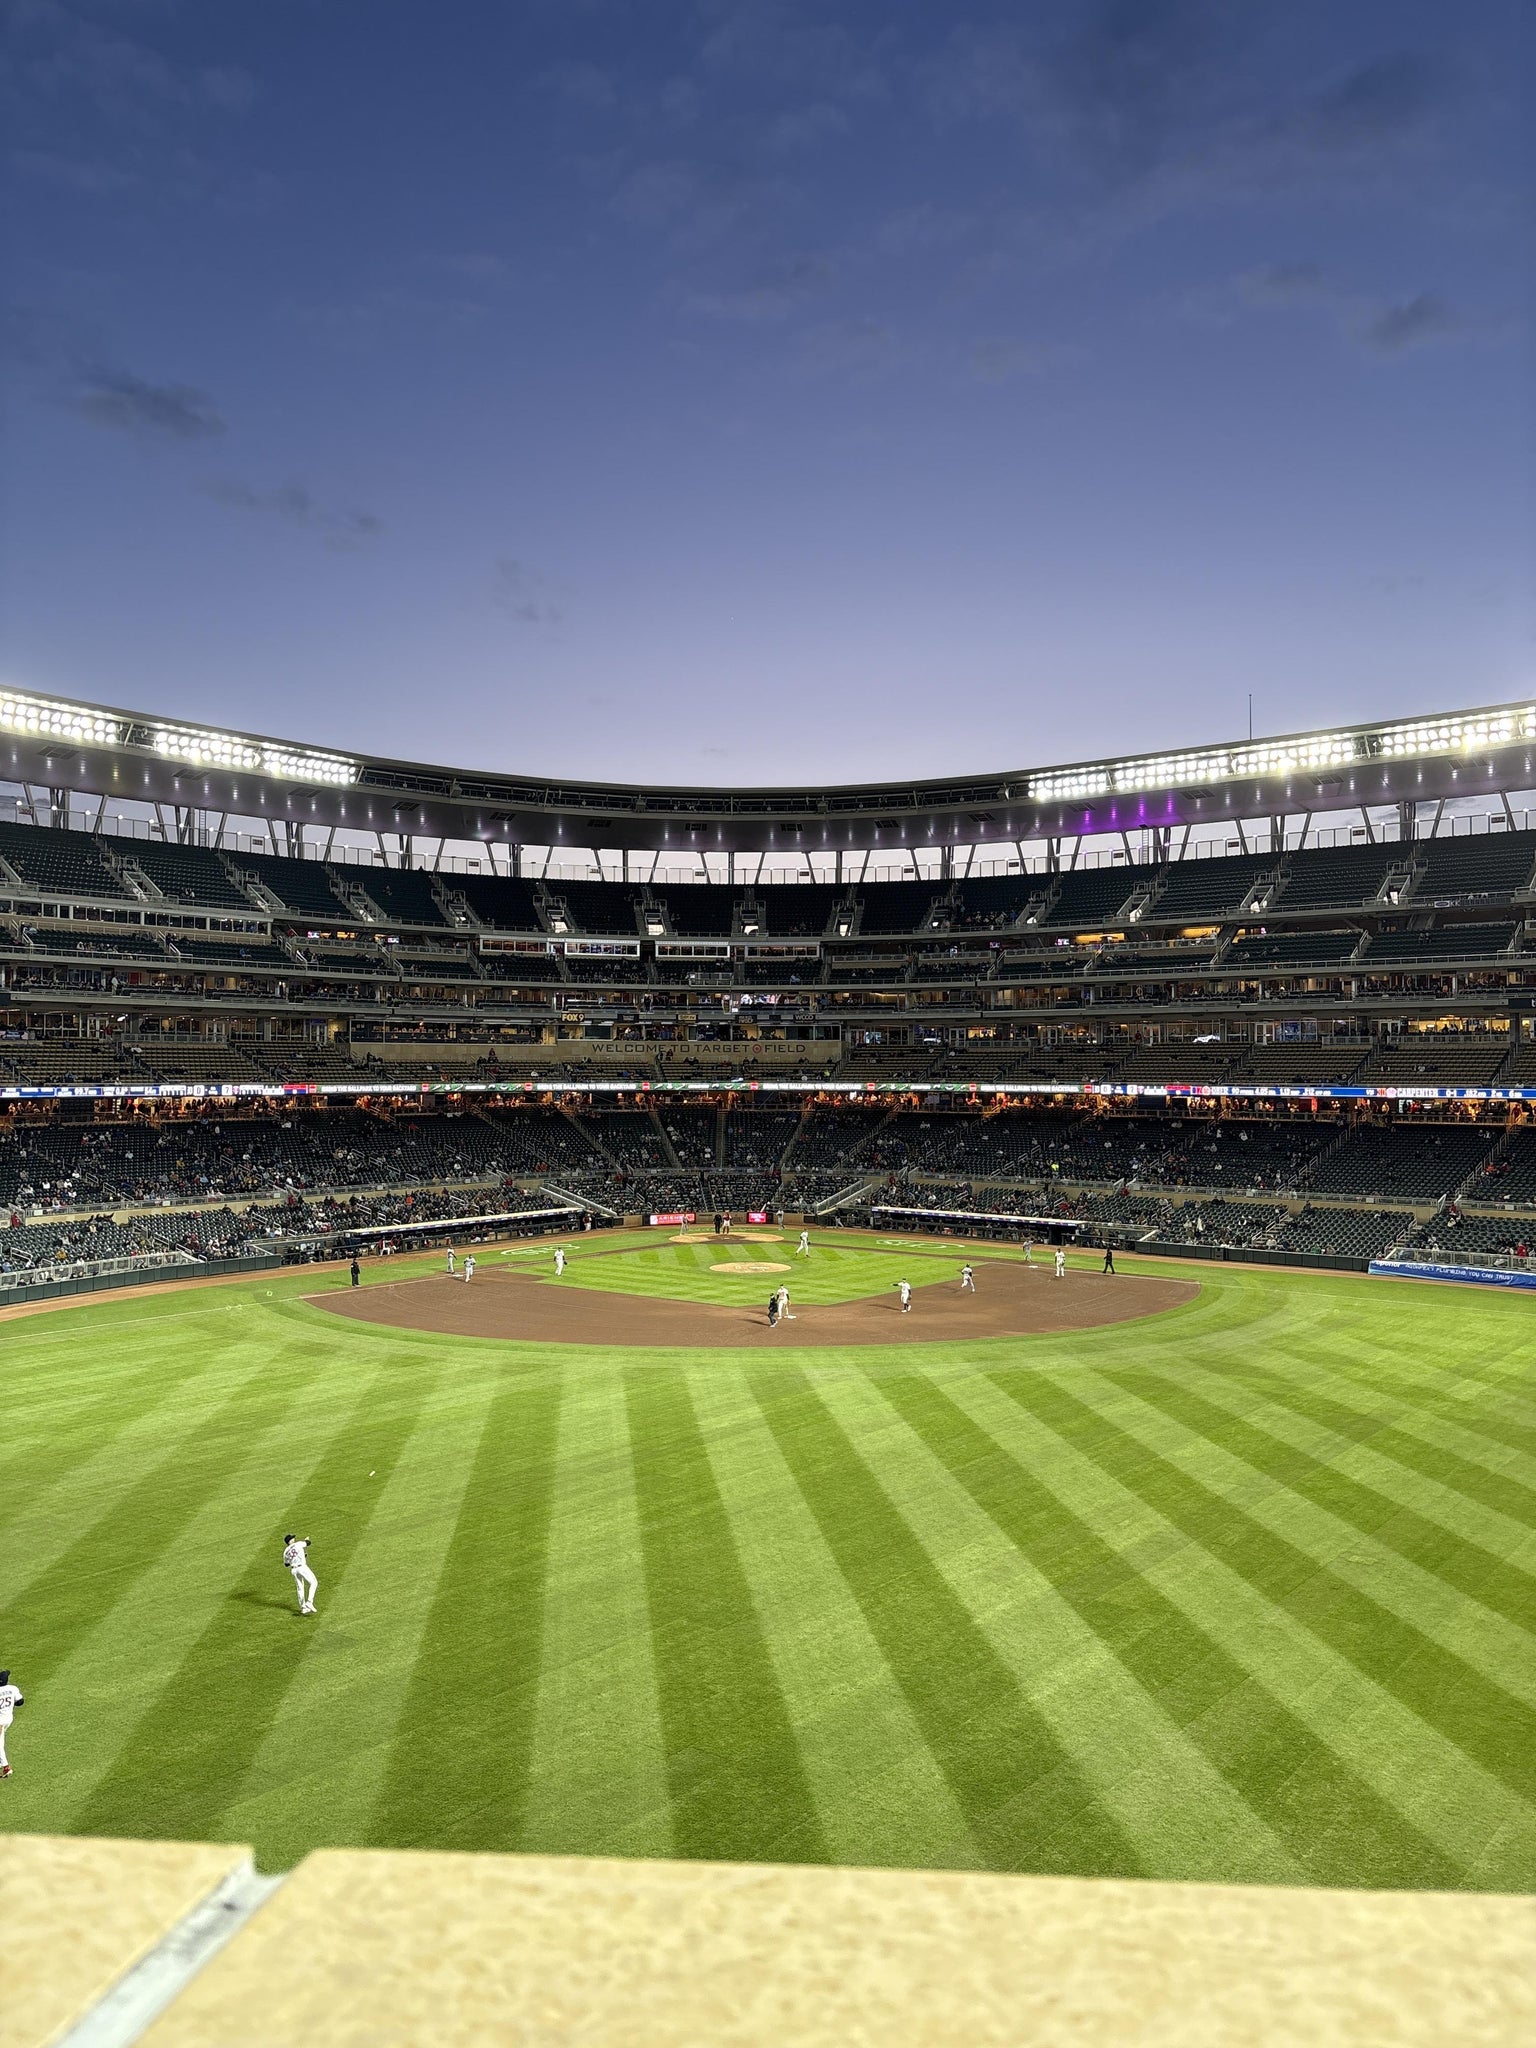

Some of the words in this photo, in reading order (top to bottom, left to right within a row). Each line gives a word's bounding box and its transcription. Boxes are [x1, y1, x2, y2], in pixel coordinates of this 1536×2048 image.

[562, 1014, 578, 1022] FOX
[579, 1014, 584, 1022] 9
[592, 1044, 666, 1052] WELCOME
[670, 1044, 690, 1052] TO
[694, 1044, 750, 1052] TARGET
[764, 1044, 806, 1052] FIELD
[1397, 1088, 1438, 1097] CARPENTER
